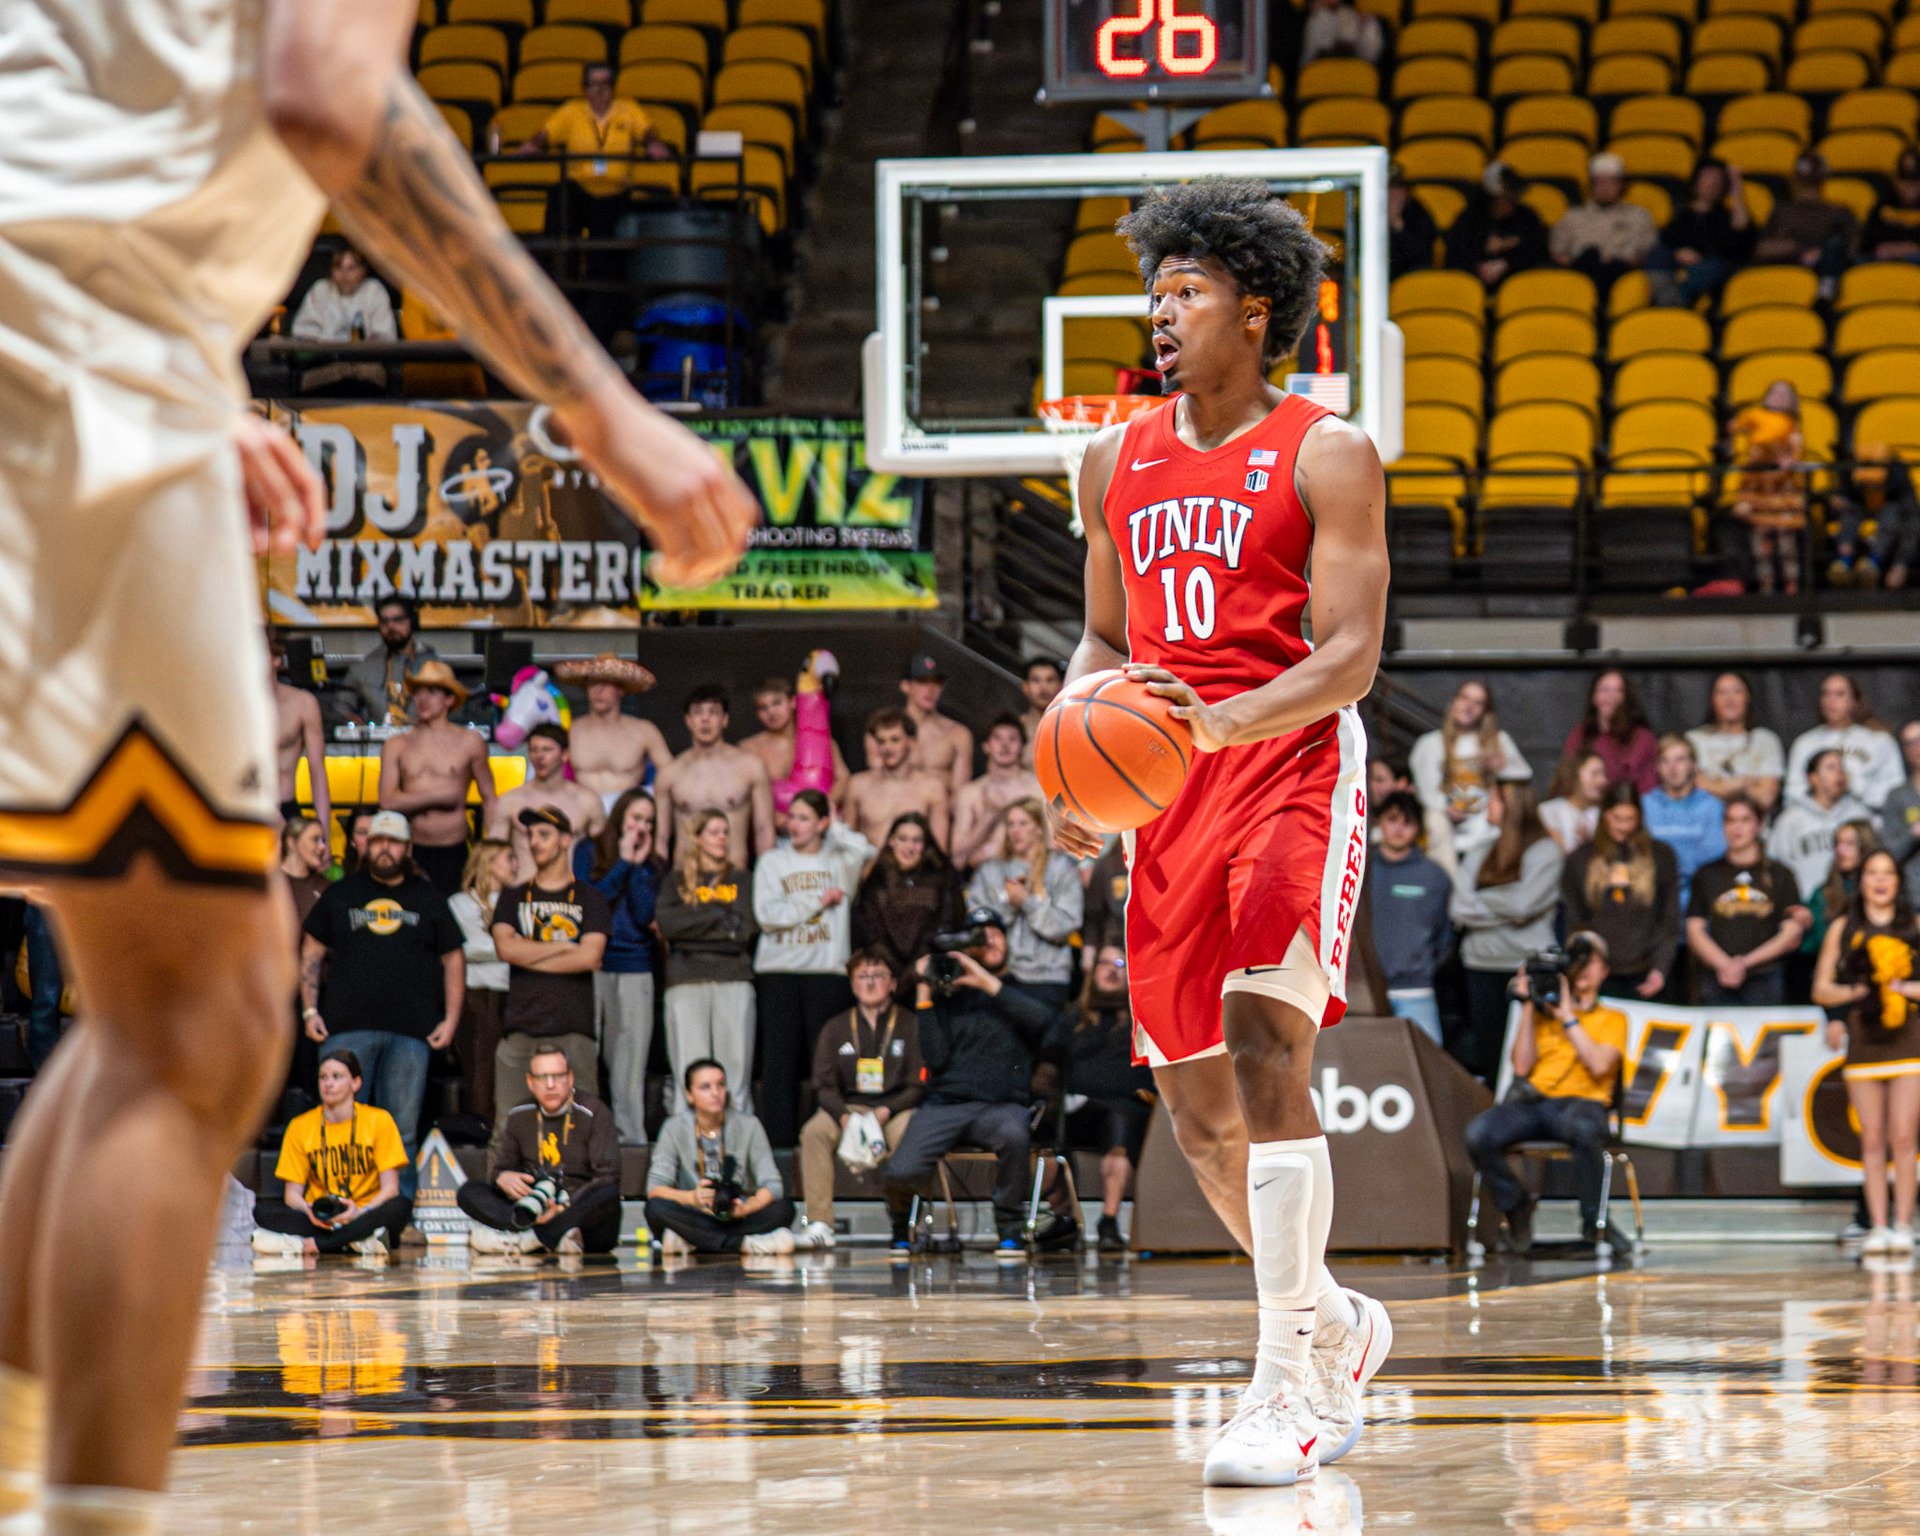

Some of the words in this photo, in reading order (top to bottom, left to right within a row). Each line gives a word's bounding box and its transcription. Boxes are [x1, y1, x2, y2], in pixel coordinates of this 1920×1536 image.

[1096, 0, 1217, 77] 26
[294, 423, 425, 532] DJ
[746, 527, 837, 547] SHOOTING
[1128, 496, 1254, 576] UNLV
[731, 583, 831, 600] TRACKER
[1160, 566, 1216, 642] 10
[1331, 788, 1366, 971] REBELS
[1309, 1067, 1415, 1134] bo
[308, 1143, 378, 1180] WYOMING
